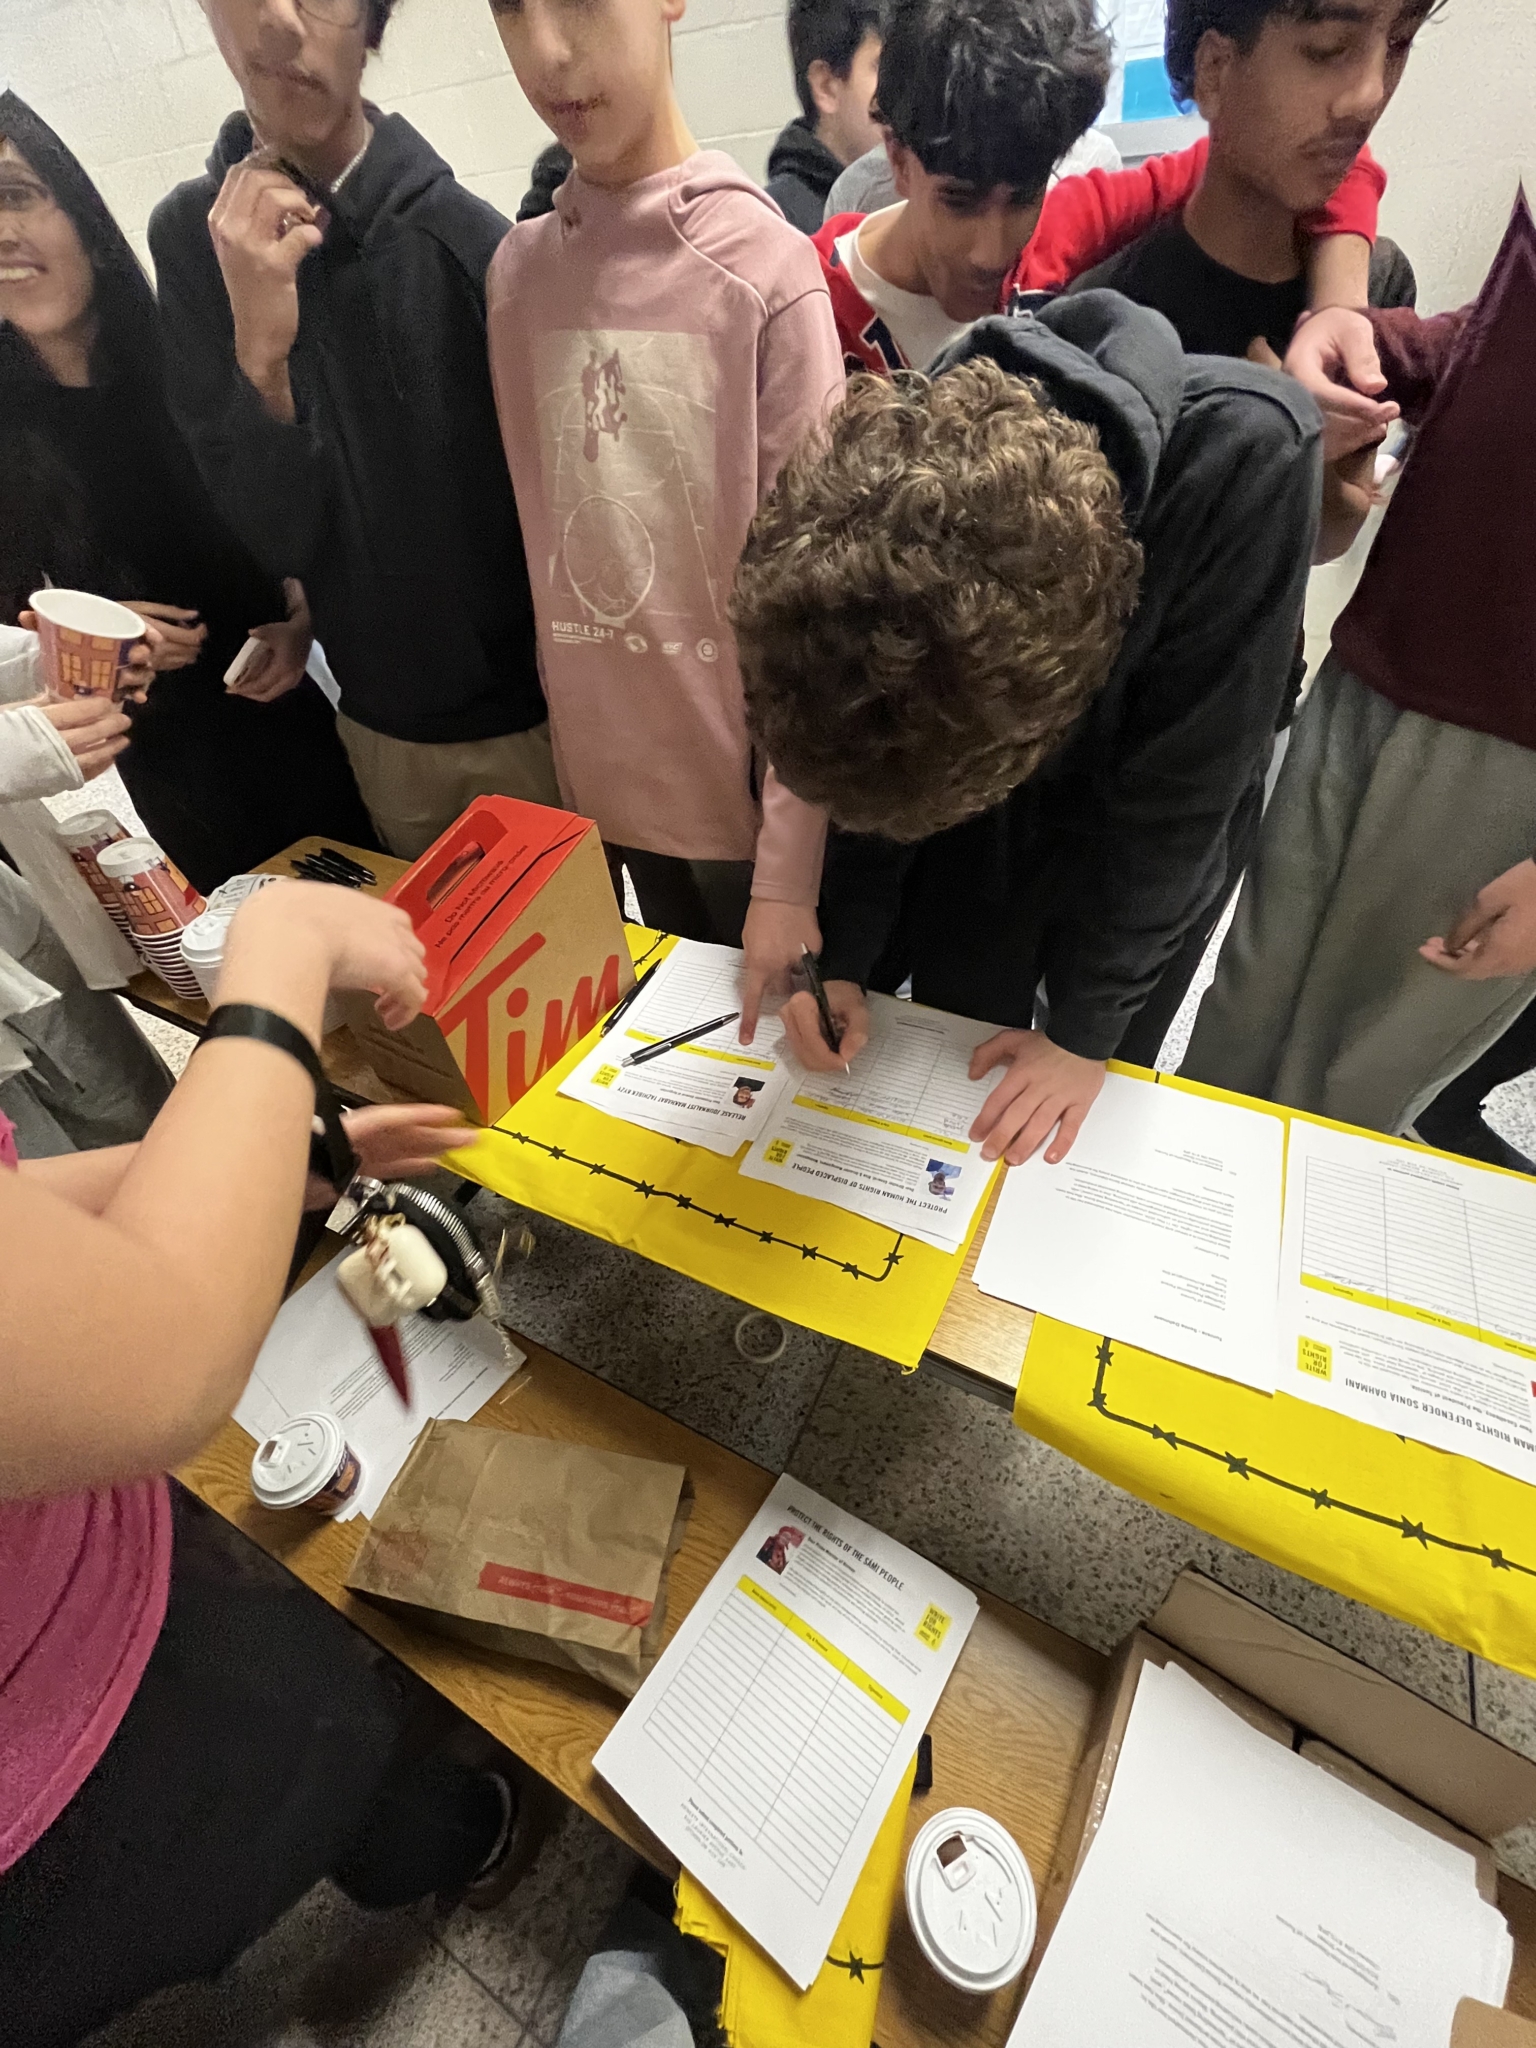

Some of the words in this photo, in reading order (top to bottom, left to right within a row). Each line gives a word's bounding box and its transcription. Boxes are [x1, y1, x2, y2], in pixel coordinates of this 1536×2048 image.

[551, 620, 595, 637] HUSTLE
[593, 627, 614, 639] 24-7
[444, 912, 458, 923] Do
[455, 897, 470, 910] Not
[687, 1104, 721, 1115] JOURNALIST
[720, 1111, 746, 1121] RELEASE
[792, 1163, 815, 1175] PEOPLE
[815, 1170, 848, 1185] DISPLACED
[858, 1183, 881, 1195] RIGHTS
[882, 1191, 904, 1201] HUMAN
[906, 1197, 917, 1206] THE
[918, 1201, 948, 1214] PROTECT
[1302, 1348, 1327, 1363] RIGHTS
[1305, 1362, 1327, 1376] WRITE
[1313, 1360, 1327, 1370] FOR
[1345, 1378, 1387, 1399] DAHMANI
[1390, 1392, 1419, 1409] SONIA
[1422, 1403, 1472, 1428] DEFENDER
[1475, 1422, 1511, 1443] RIGHTS
[1513, 1437, 1536, 1452] MAN
[787, 1505, 812, 1524] PROTECT
[812, 1521, 823, 1532] THE
[822, 1527, 844, 1547] RIGHTS
[843, 1543, 853, 1552] OF
[852, 1549, 864, 1561] THE
[878, 1568, 904, 1591] PEOPLE
